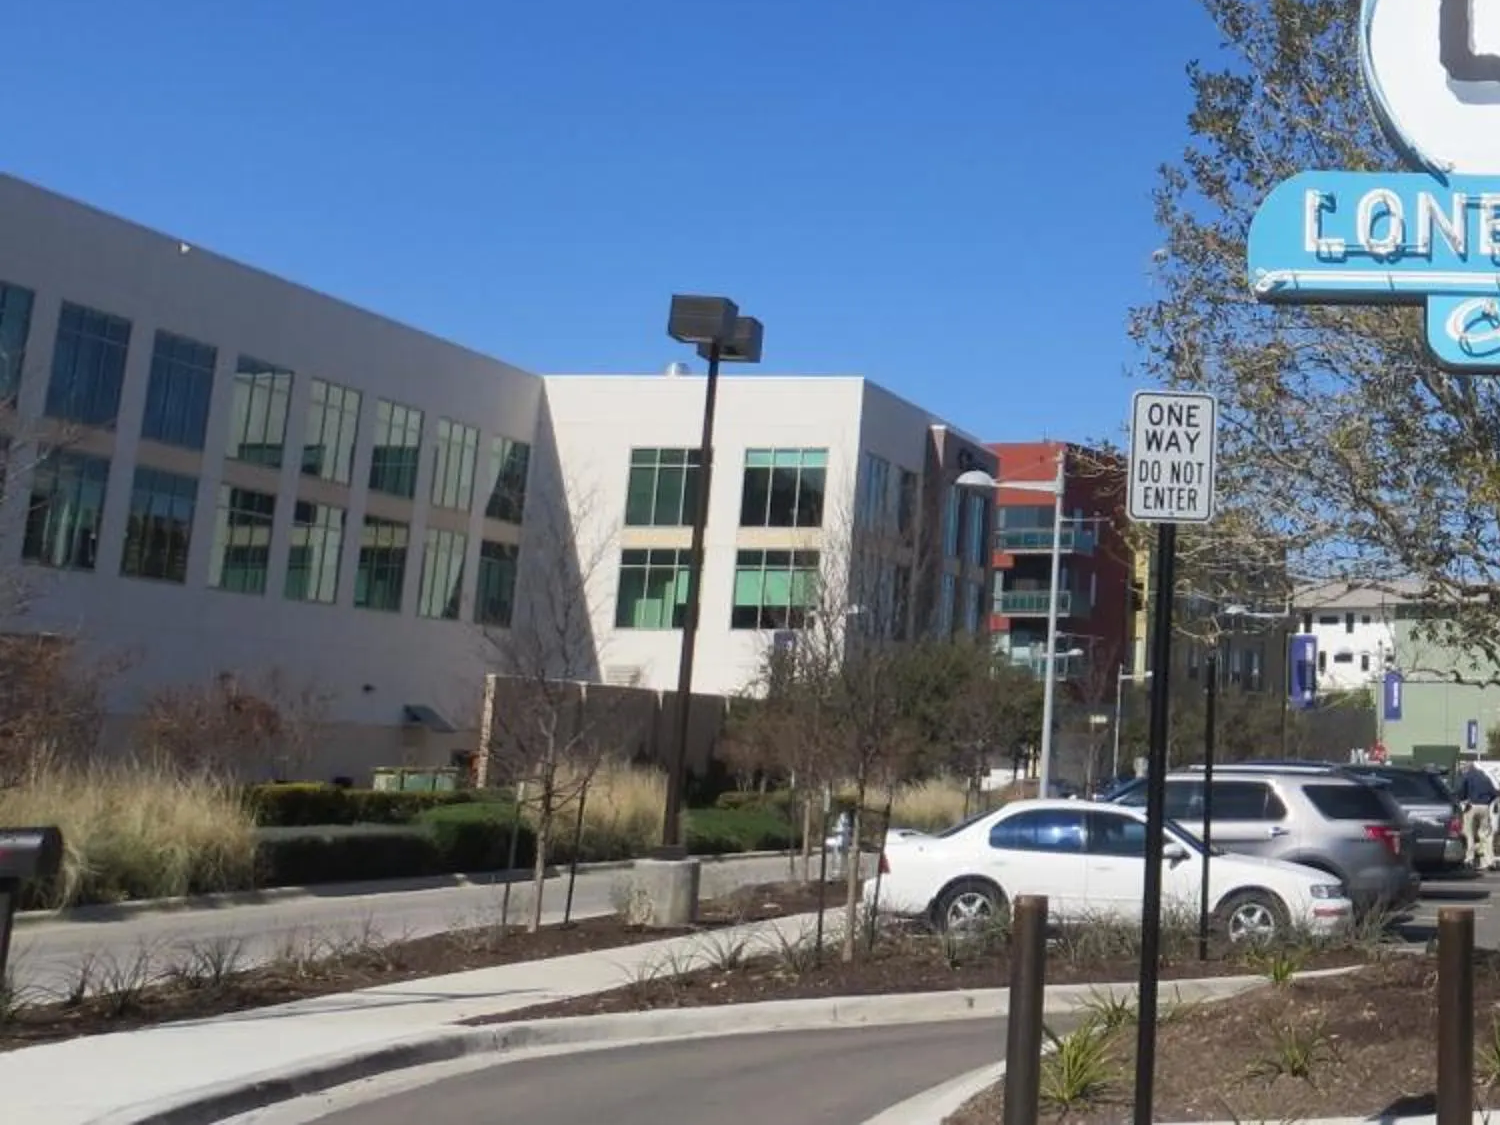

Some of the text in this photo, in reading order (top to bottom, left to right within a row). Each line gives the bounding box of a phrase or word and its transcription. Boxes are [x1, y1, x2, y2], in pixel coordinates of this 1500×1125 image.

[1148, 402, 1201, 427] ONE
[1145, 429, 1200, 454] WAY
[1138, 459, 1204, 484] DO NOT
[1143, 486, 1198, 511] ENTER
